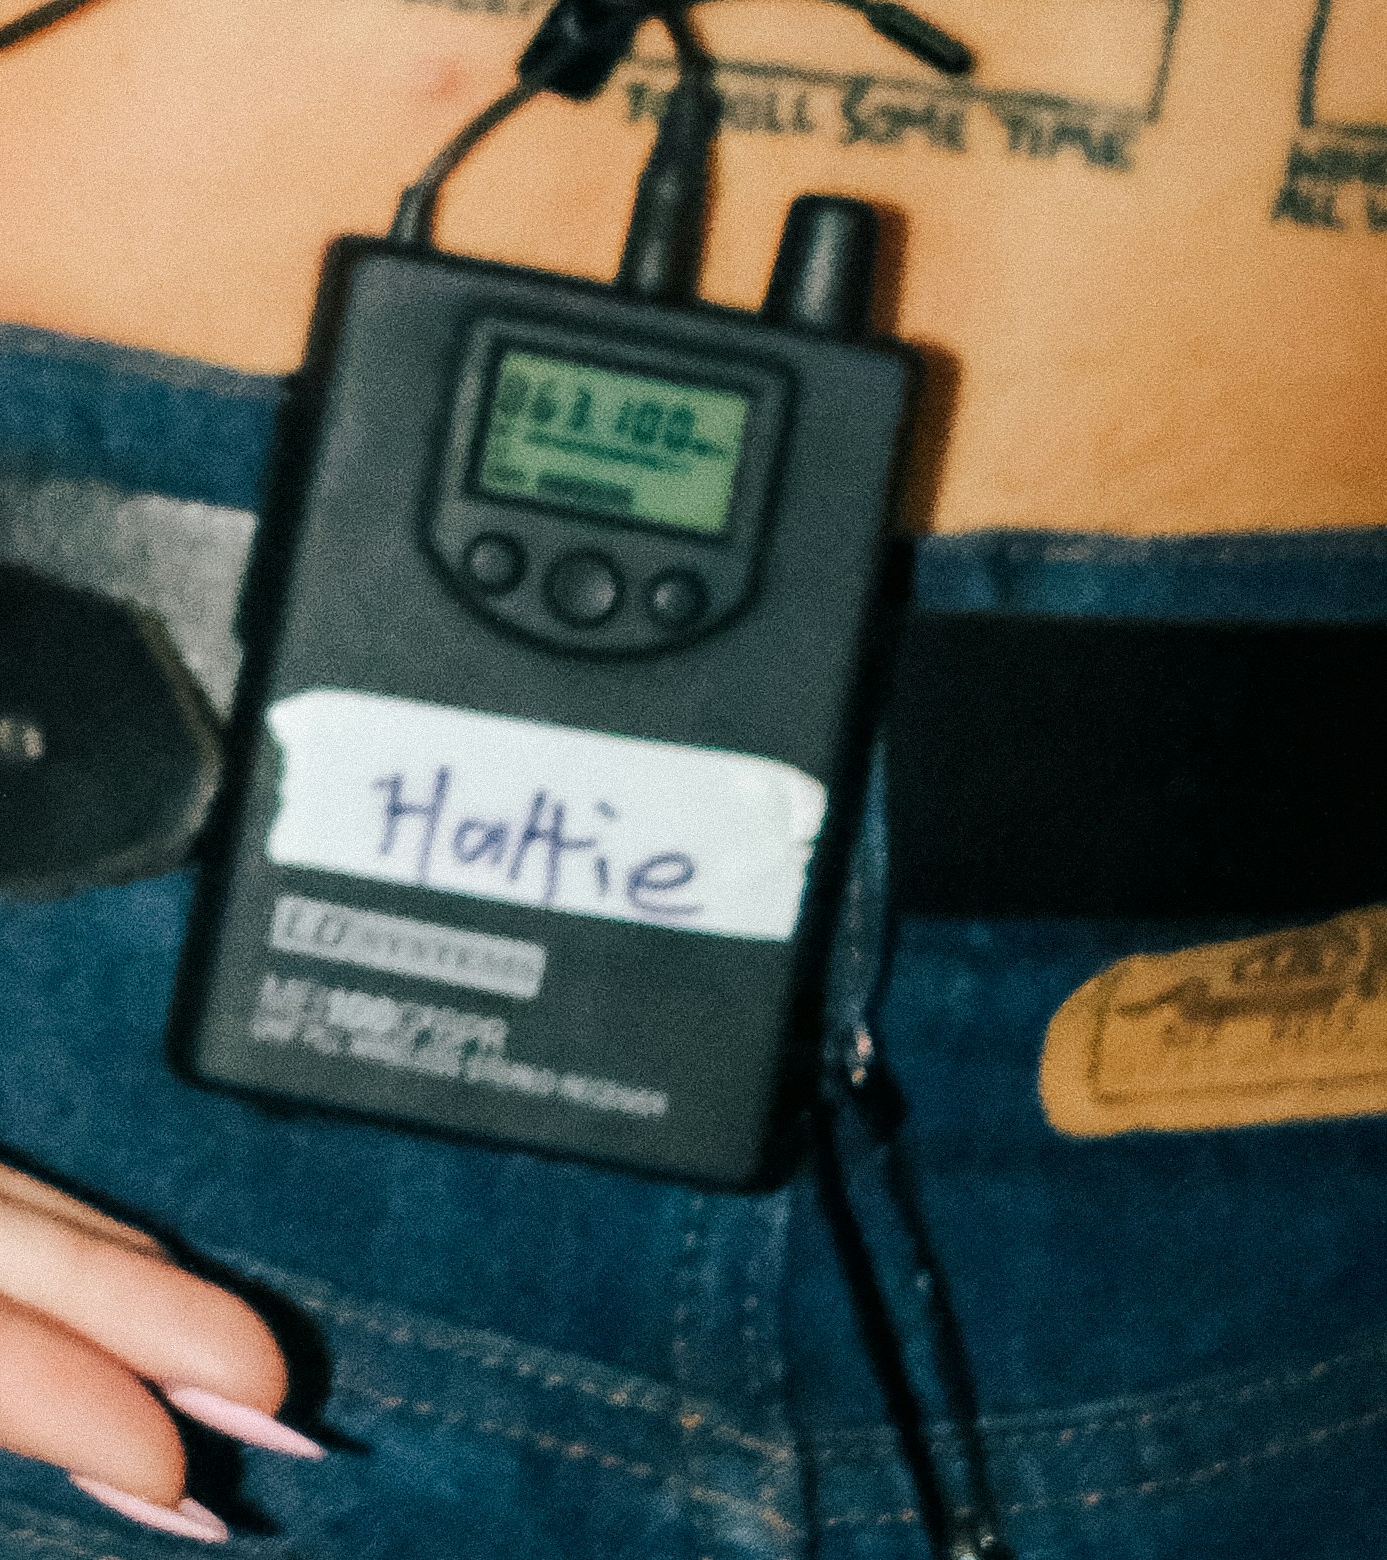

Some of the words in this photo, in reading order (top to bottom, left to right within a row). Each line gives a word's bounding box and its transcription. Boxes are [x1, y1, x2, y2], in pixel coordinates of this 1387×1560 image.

[841, 77, 966, 152] SOME
[989, 102, 1136, 171] TIME
[370, 764, 704, 918] Hattie
